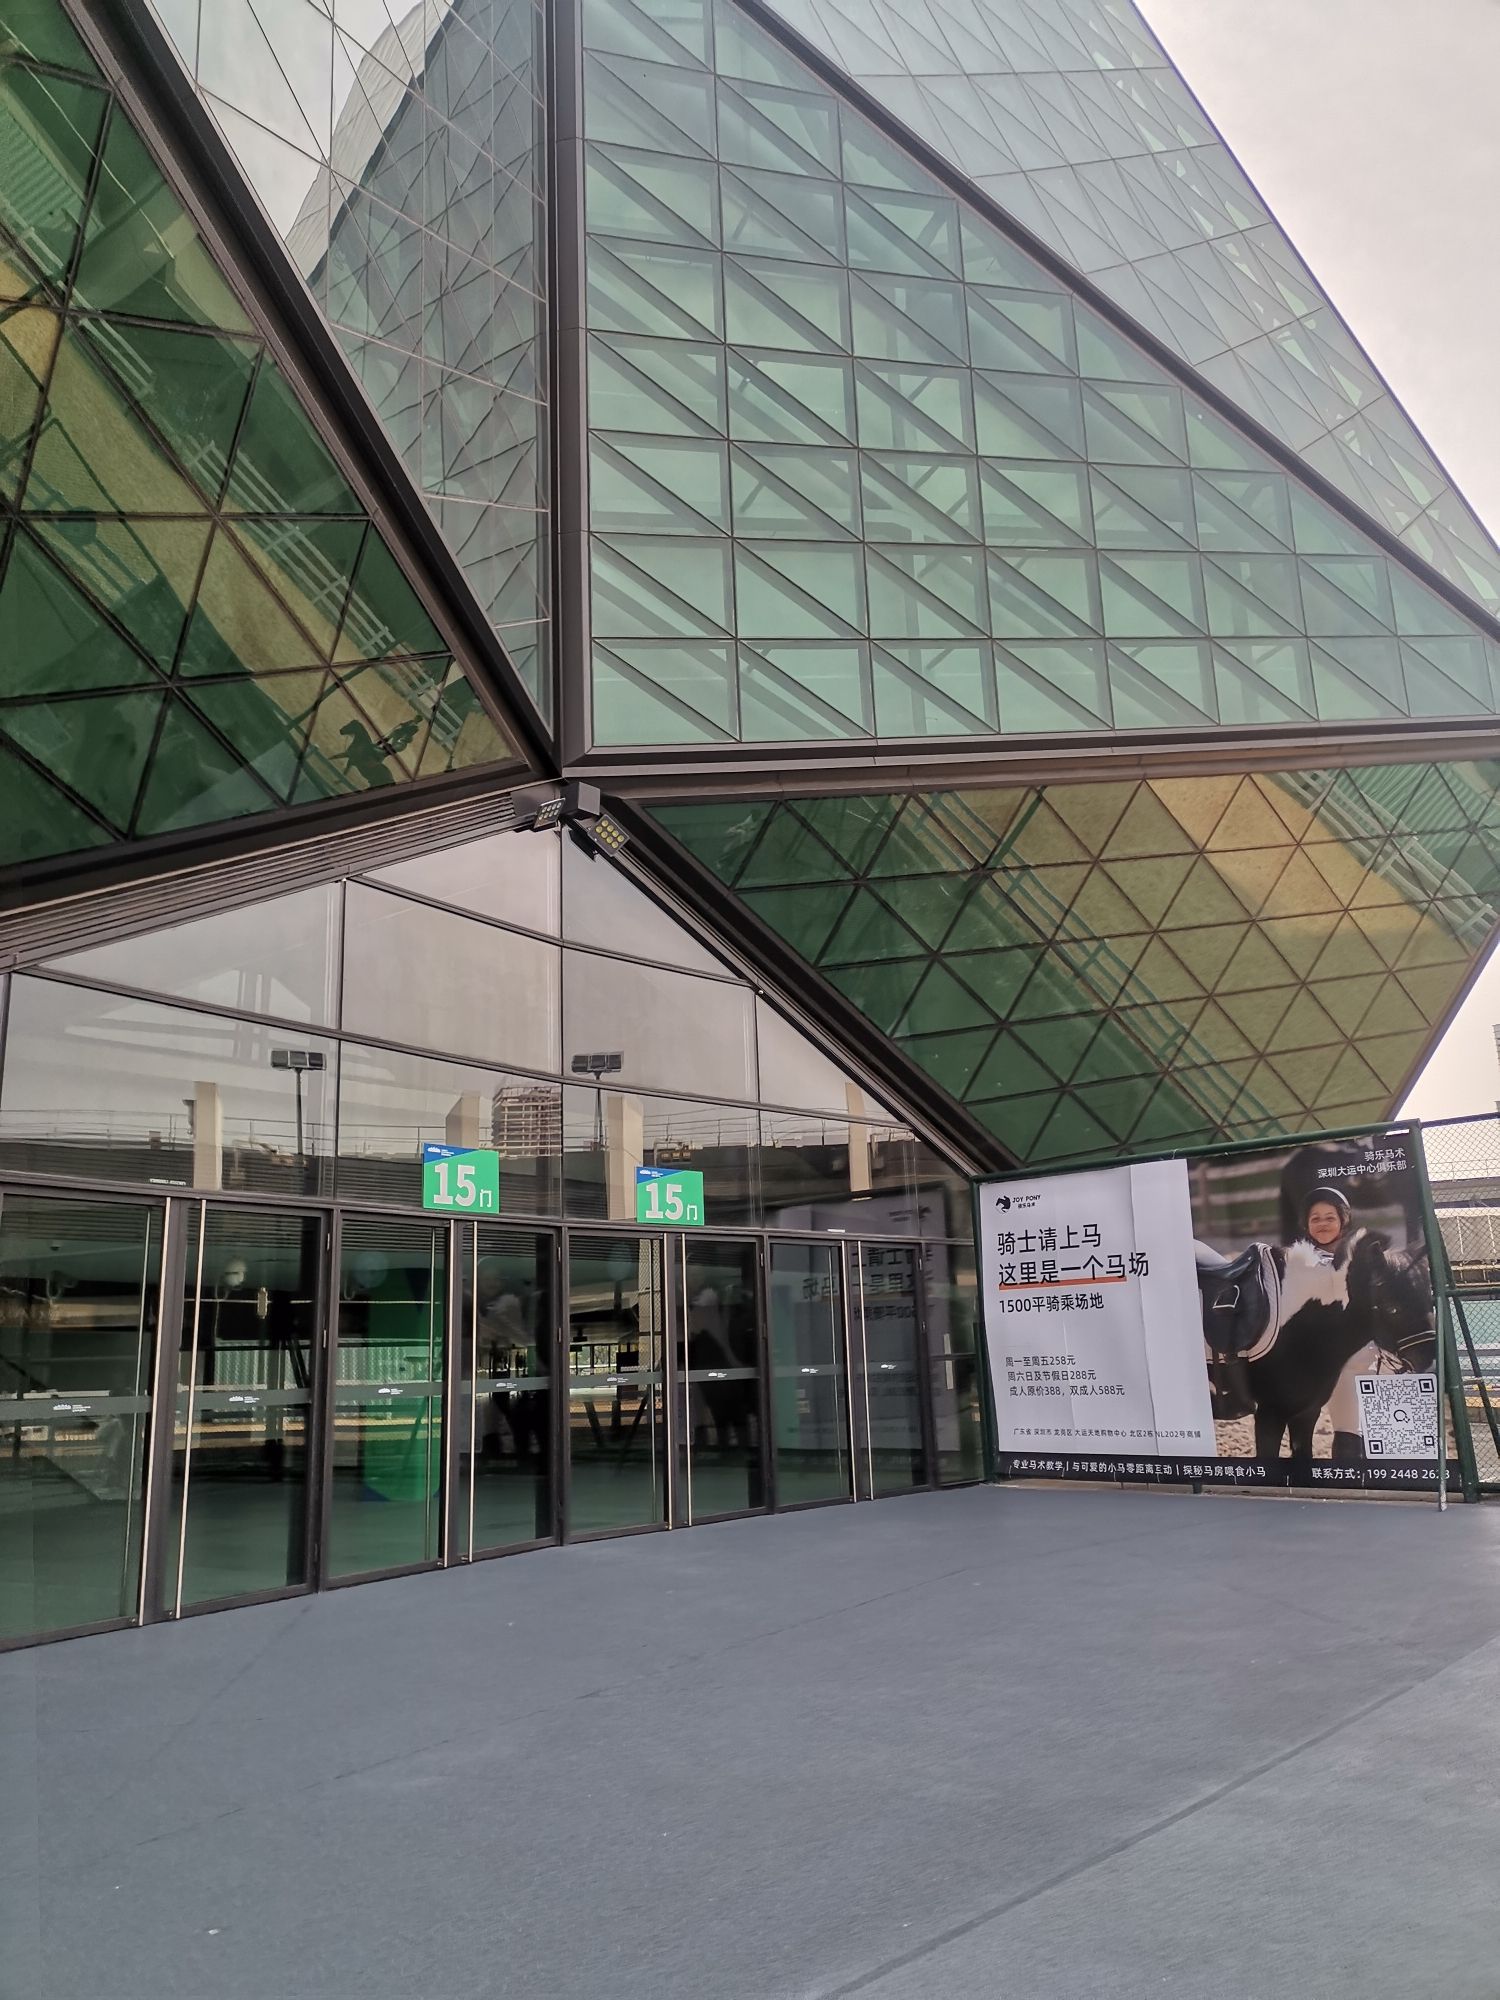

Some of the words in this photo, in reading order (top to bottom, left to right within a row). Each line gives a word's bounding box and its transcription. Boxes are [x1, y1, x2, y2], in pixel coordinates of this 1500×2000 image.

[1364, 1148, 1406, 1162] 骑乐马术
[1317, 1160, 1408, 1179] 深圳大运中心俱乐部
[997, 1223, 1102, 1256] 骑士请上马
[999, 1252, 1150, 1286] 这里是一个马场
[999, 1292, 1105, 1313] 1500平骑乘场地
[1005, 1354, 1076, 1367] 周一至周五258元
[1007, 1369, 1097, 1382] 周六日及节假日288元
[1367, 1469, 1387, 1479] 199
[1390, 1469, 1418, 1479] 2448
